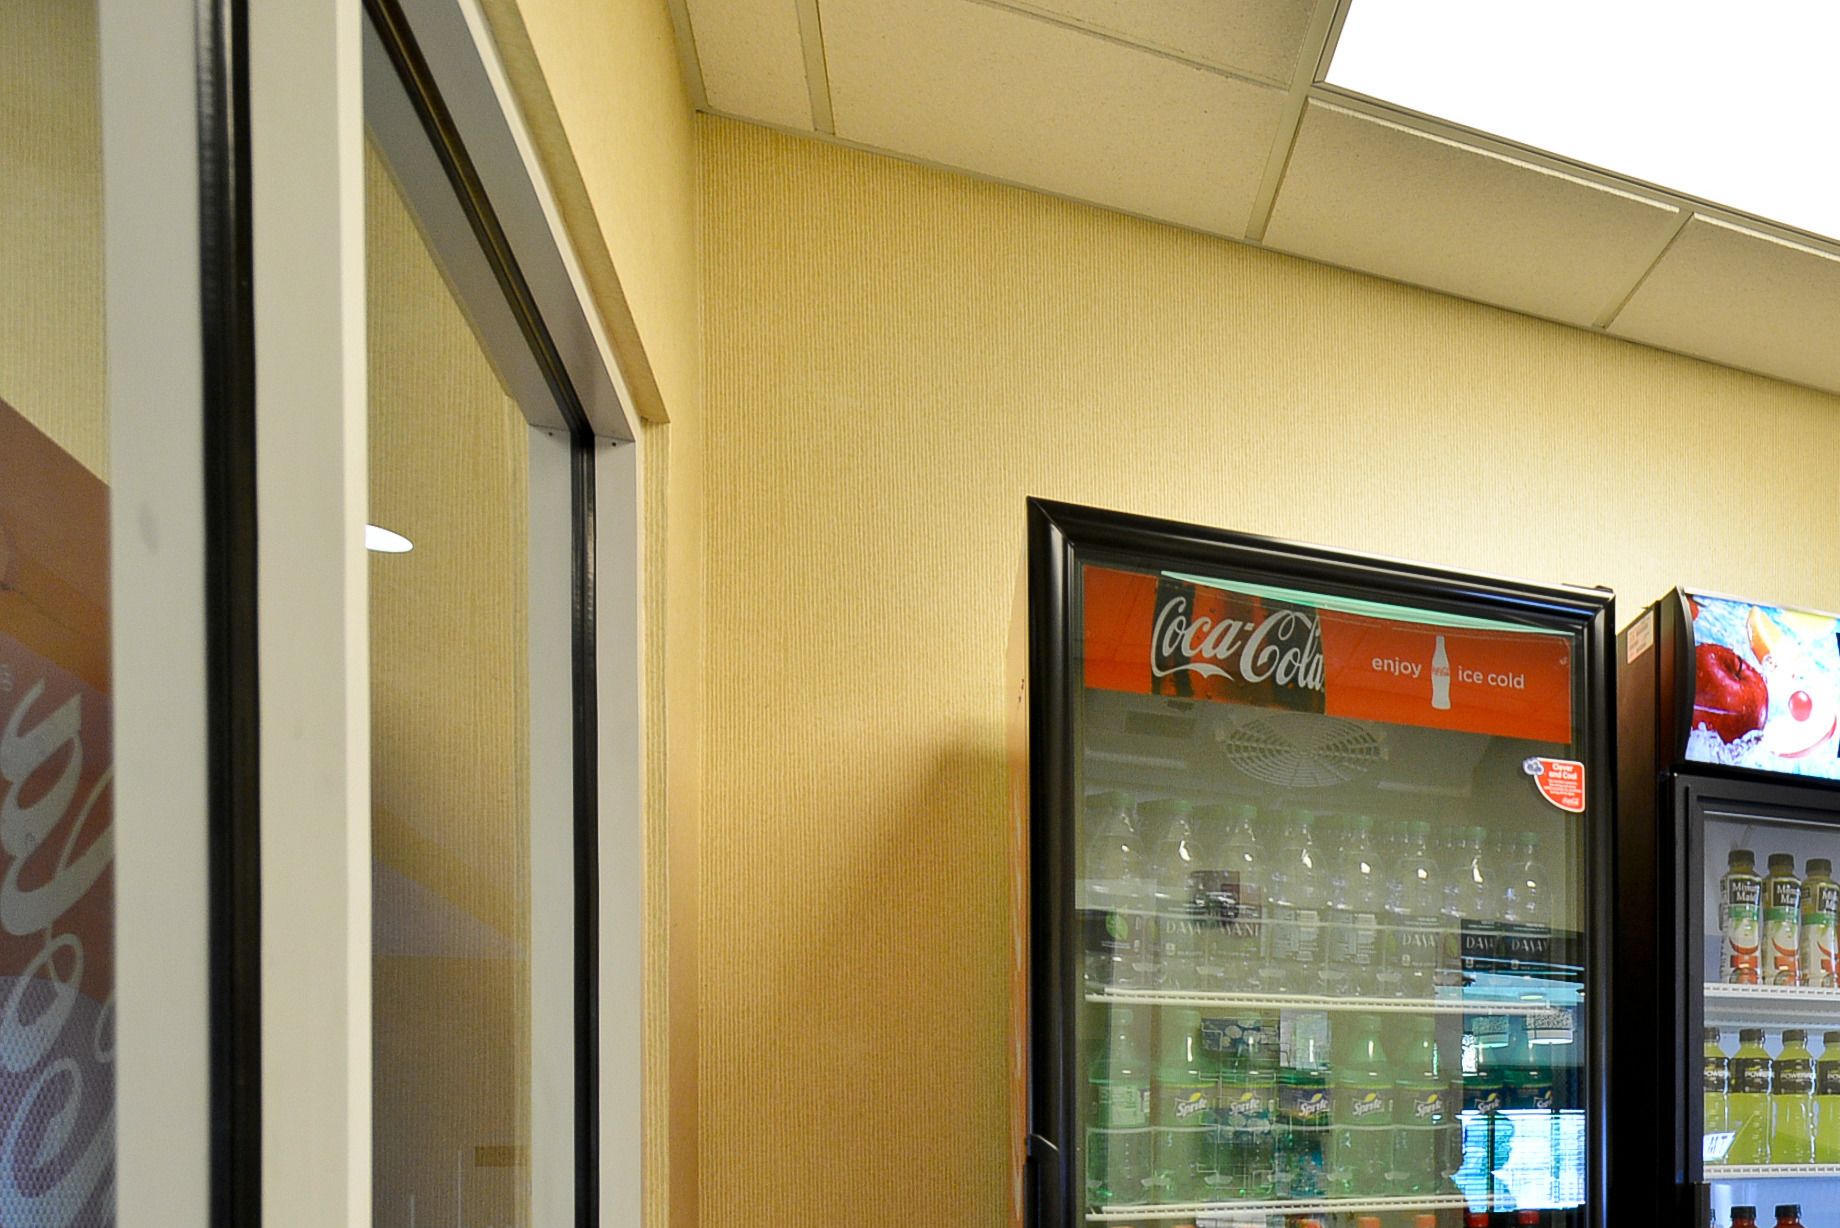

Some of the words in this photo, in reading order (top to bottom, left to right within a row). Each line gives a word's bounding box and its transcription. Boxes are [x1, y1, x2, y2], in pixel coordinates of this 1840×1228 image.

[1151, 597, 1325, 691] Coca-Cola
[1372, 654, 1422, 679] enjoy
[1457, 668, 1484, 684] ice
[1488, 671, 1526, 690] cold
